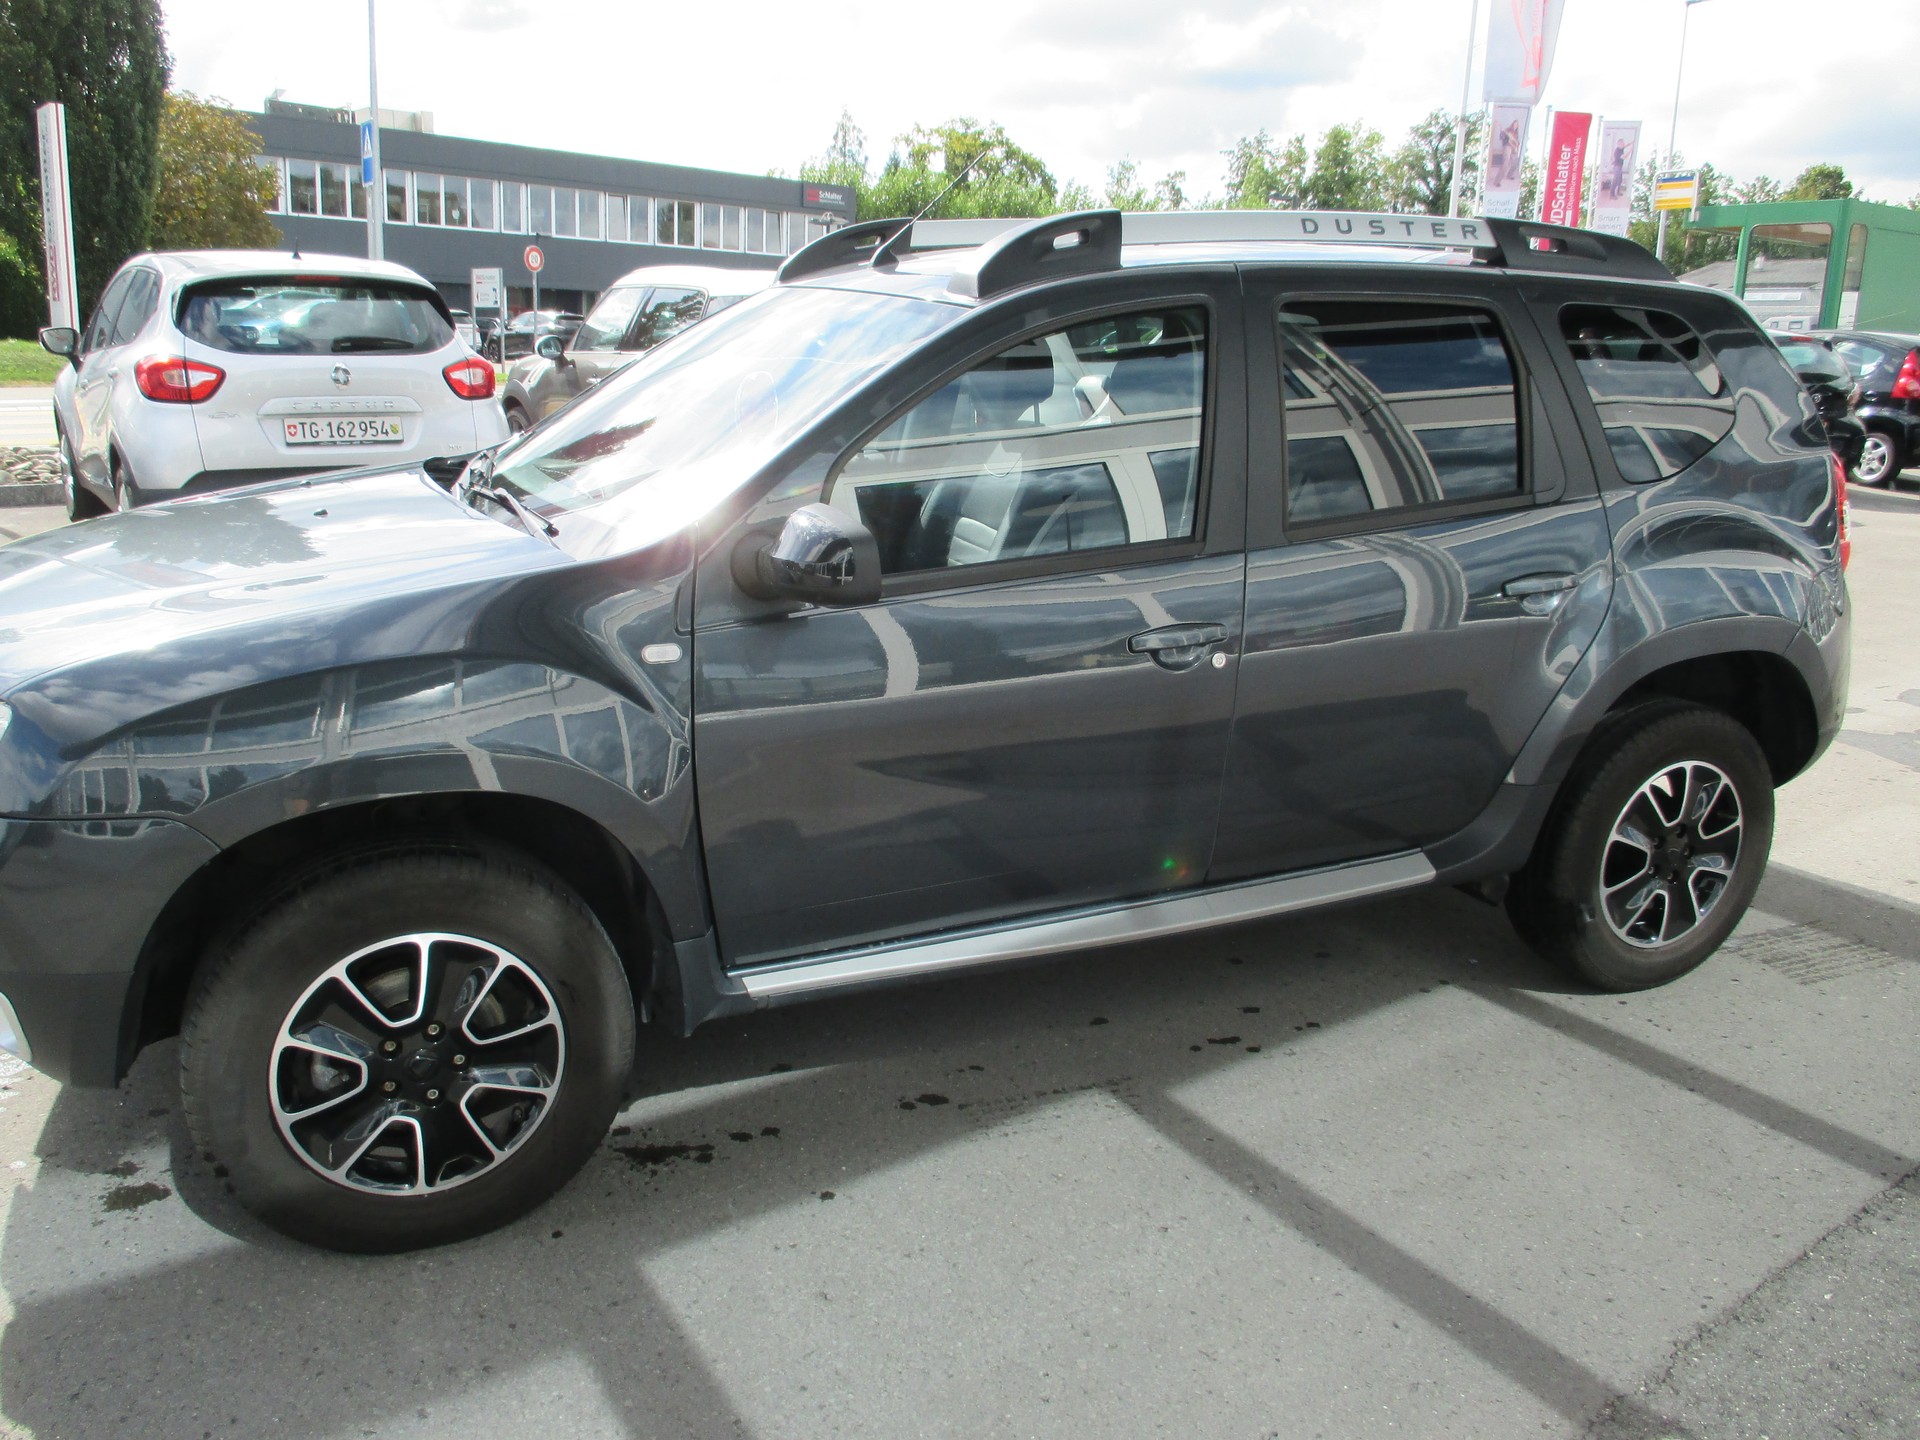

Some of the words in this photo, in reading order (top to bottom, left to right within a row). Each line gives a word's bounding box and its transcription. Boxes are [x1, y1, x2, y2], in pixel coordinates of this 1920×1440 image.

[1571, 155, 1580, 171] nach
[1301, 218, 1479, 240] DUSTER
[530, 254, 539, 264] 20
[292, 401, 394, 409] CAPTUR
